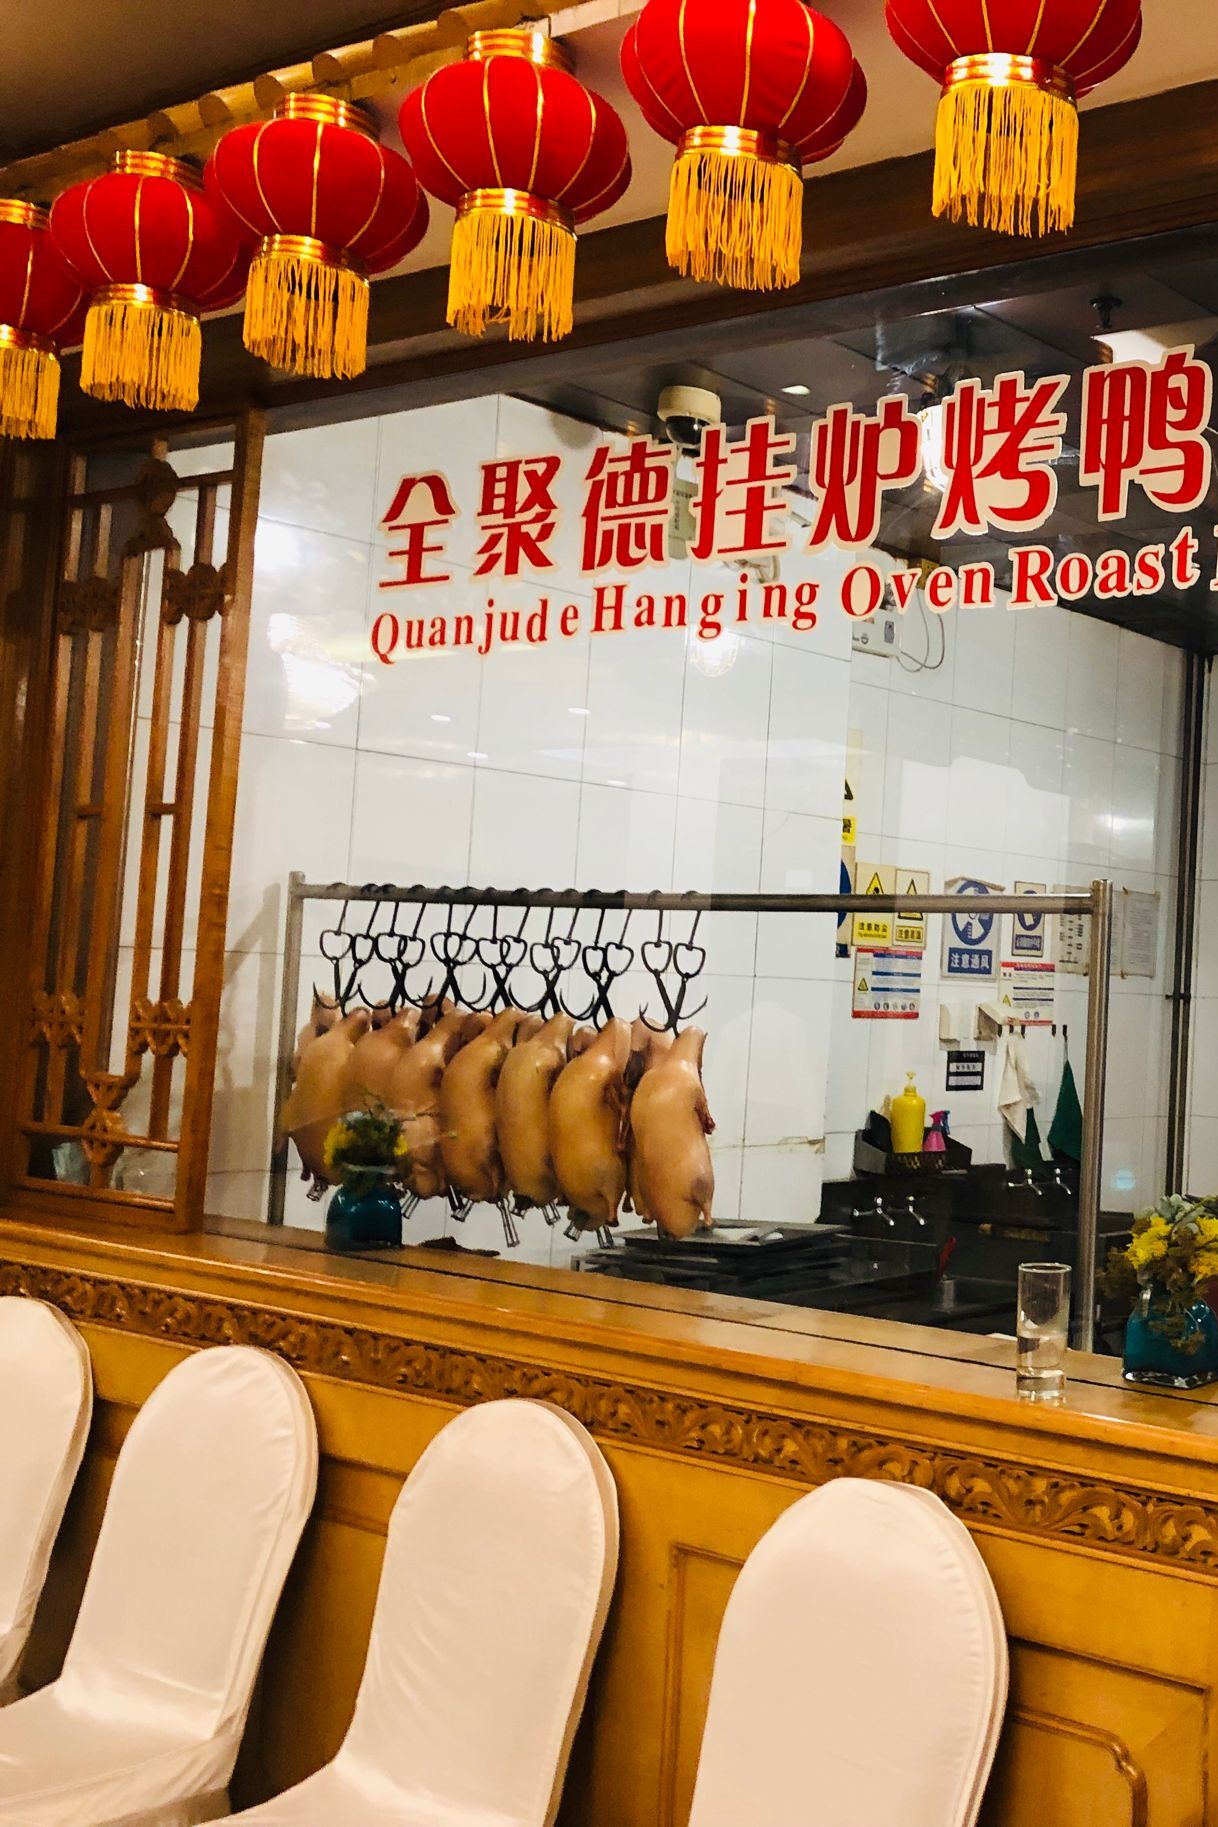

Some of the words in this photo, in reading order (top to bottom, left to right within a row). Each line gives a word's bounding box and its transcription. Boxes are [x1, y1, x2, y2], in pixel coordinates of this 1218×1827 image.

[369, 597, 581, 666] Quanjude
[589, 571, 821, 640] Hanging
[840, 564, 992, 617] Oven
[1012, 530, 1197, 605] Roast
